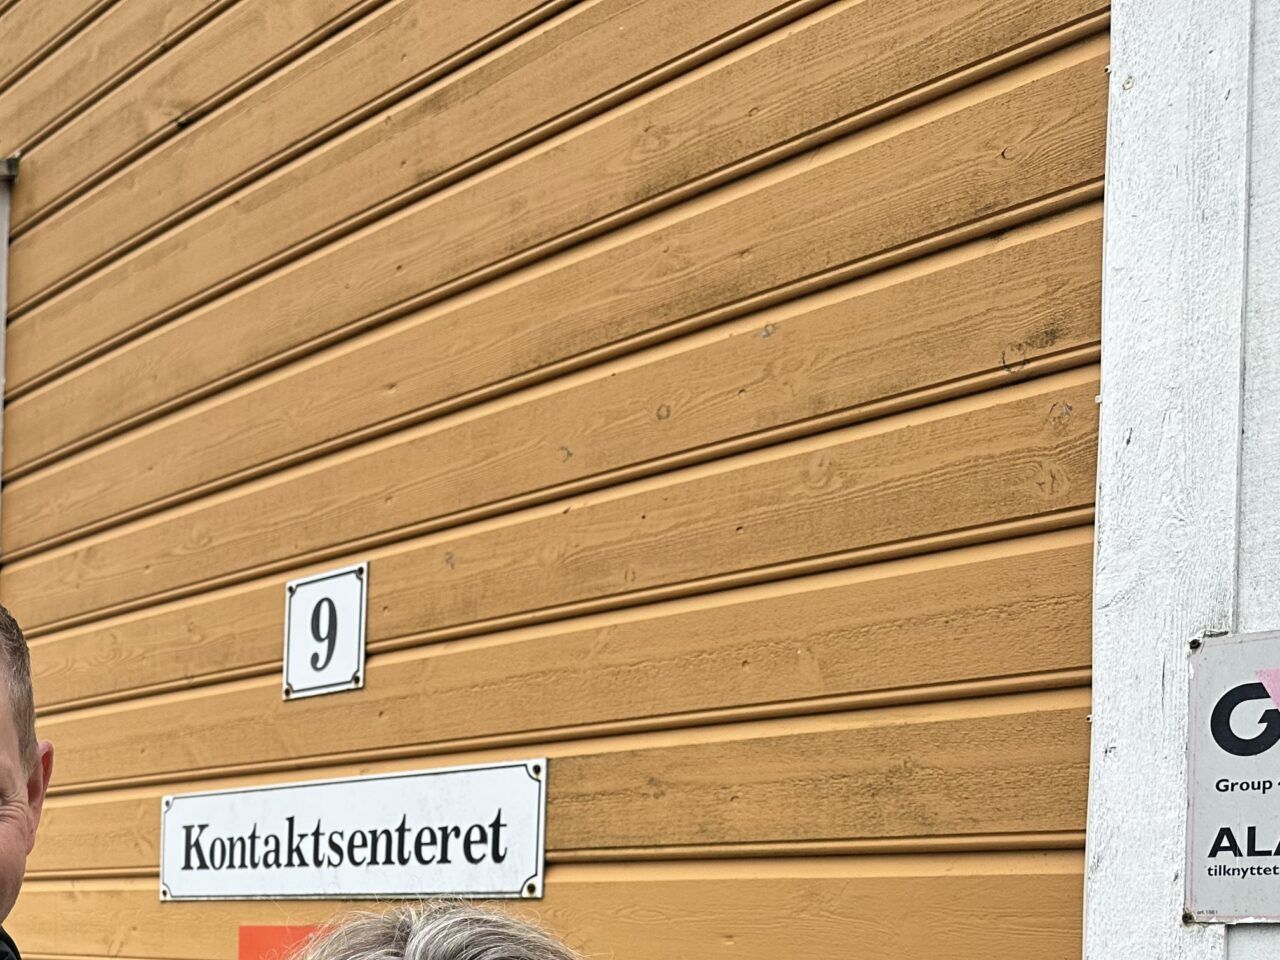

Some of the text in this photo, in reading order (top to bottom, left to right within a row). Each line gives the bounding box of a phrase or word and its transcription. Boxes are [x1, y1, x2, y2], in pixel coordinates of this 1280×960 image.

[310, 597, 338, 672] 9
[1215, 778, 1273, 794] Group
[181, 808, 508, 871] Kontaktsenteret
[1207, 826, 1280, 858] AL
[1207, 864, 1280, 879] tilknyttet
